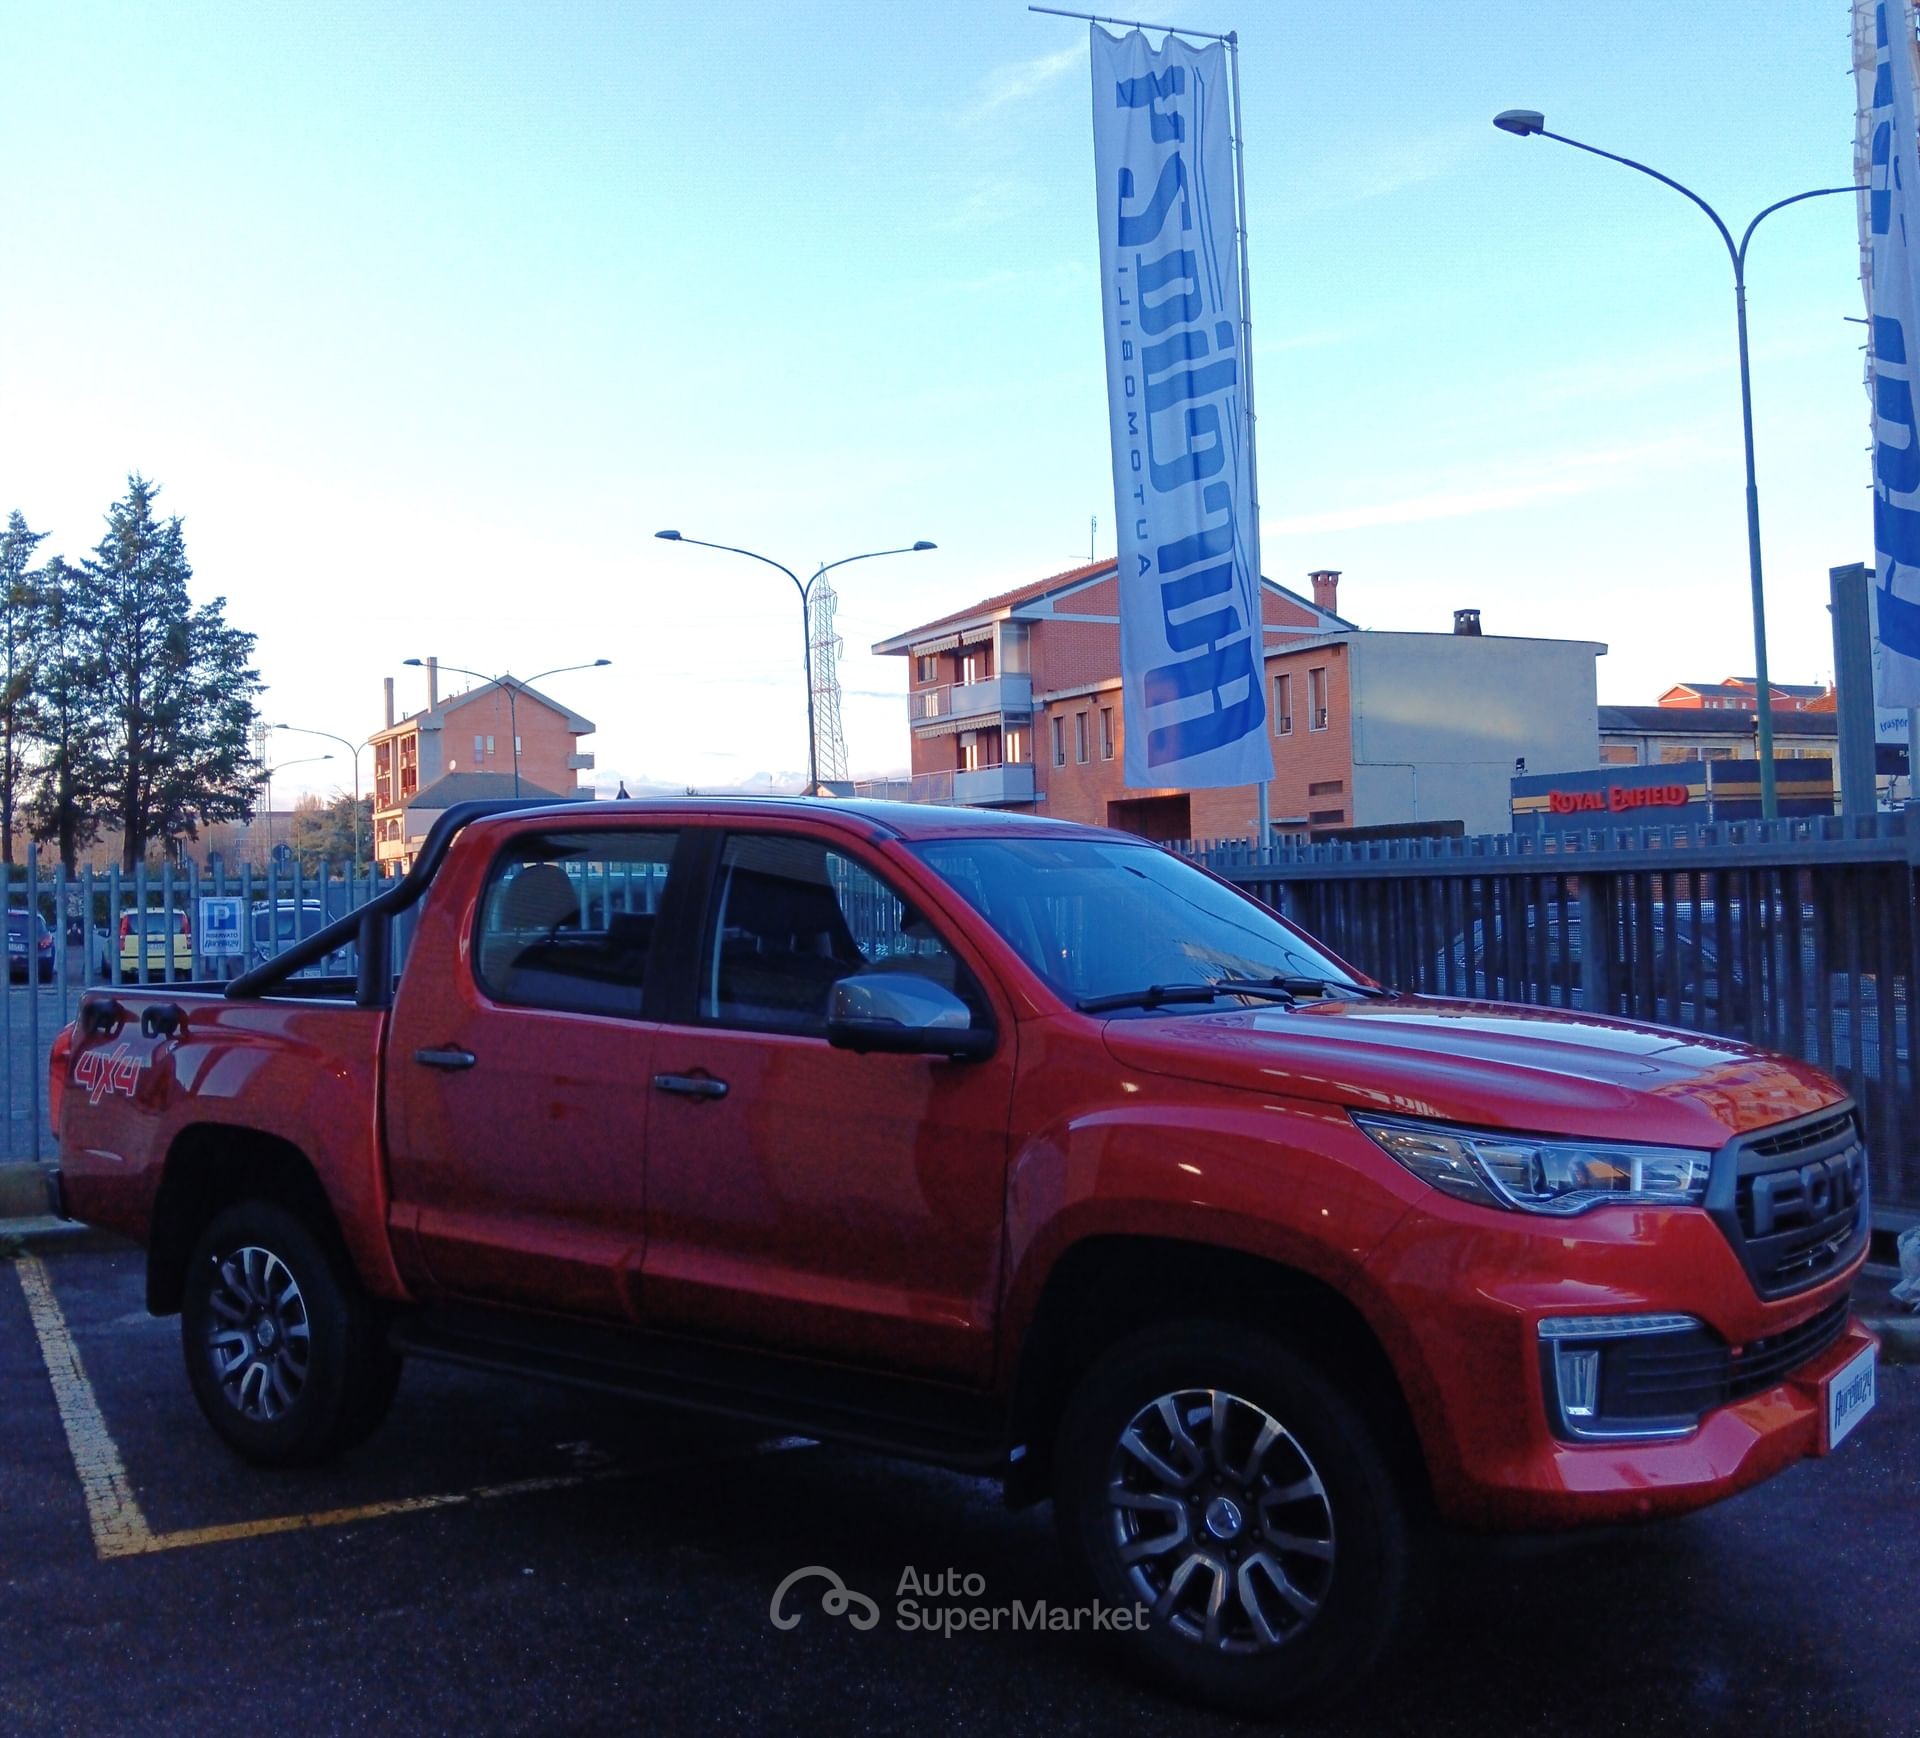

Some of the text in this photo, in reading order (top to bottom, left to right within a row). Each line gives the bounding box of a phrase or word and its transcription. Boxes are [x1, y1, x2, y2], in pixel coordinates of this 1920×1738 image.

[1549, 783, 1689, 814] ROYAL ENFIELD
[213, 904, 230, 928] P
